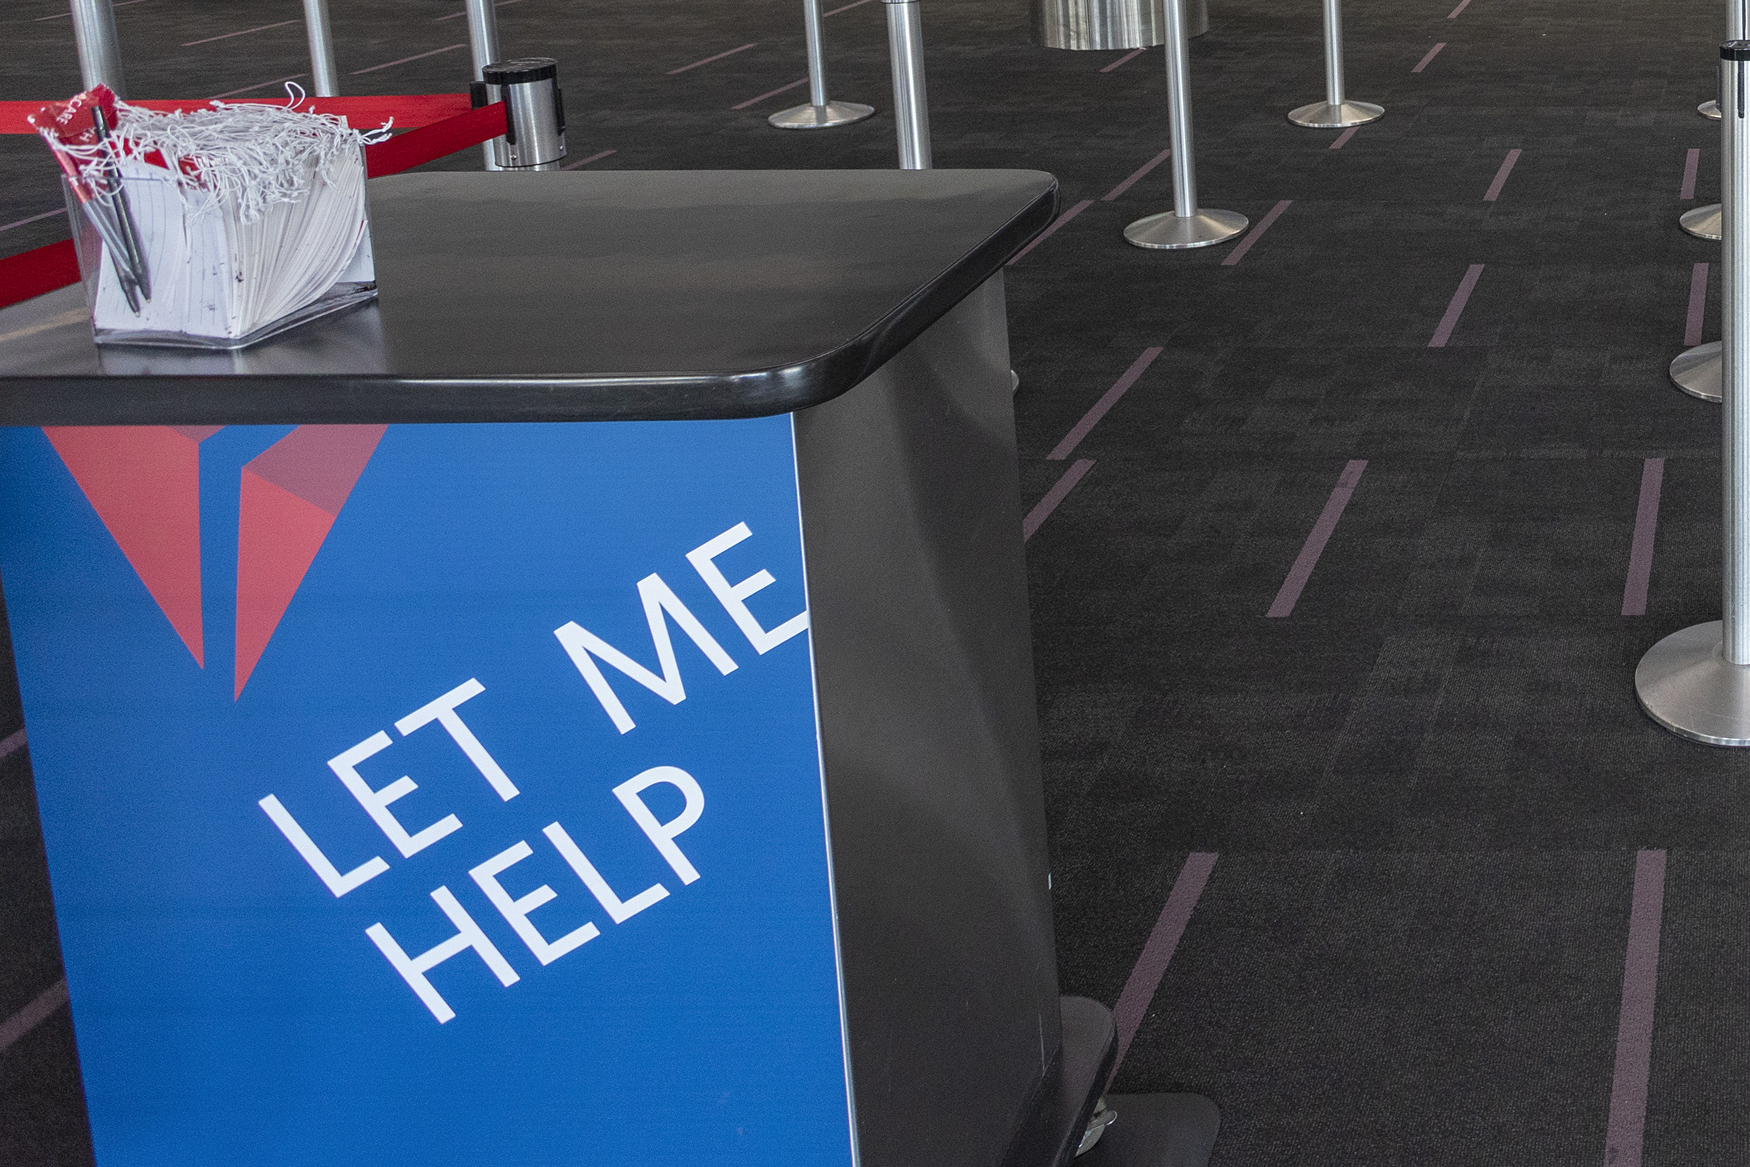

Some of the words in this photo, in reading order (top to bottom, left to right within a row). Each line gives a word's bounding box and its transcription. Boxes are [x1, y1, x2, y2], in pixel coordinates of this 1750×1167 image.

[56, 98, 82, 125] CARE
[258, 678, 522, 898] LET
[554, 521, 810, 735] ME
[366, 764, 706, 1024] HELP
